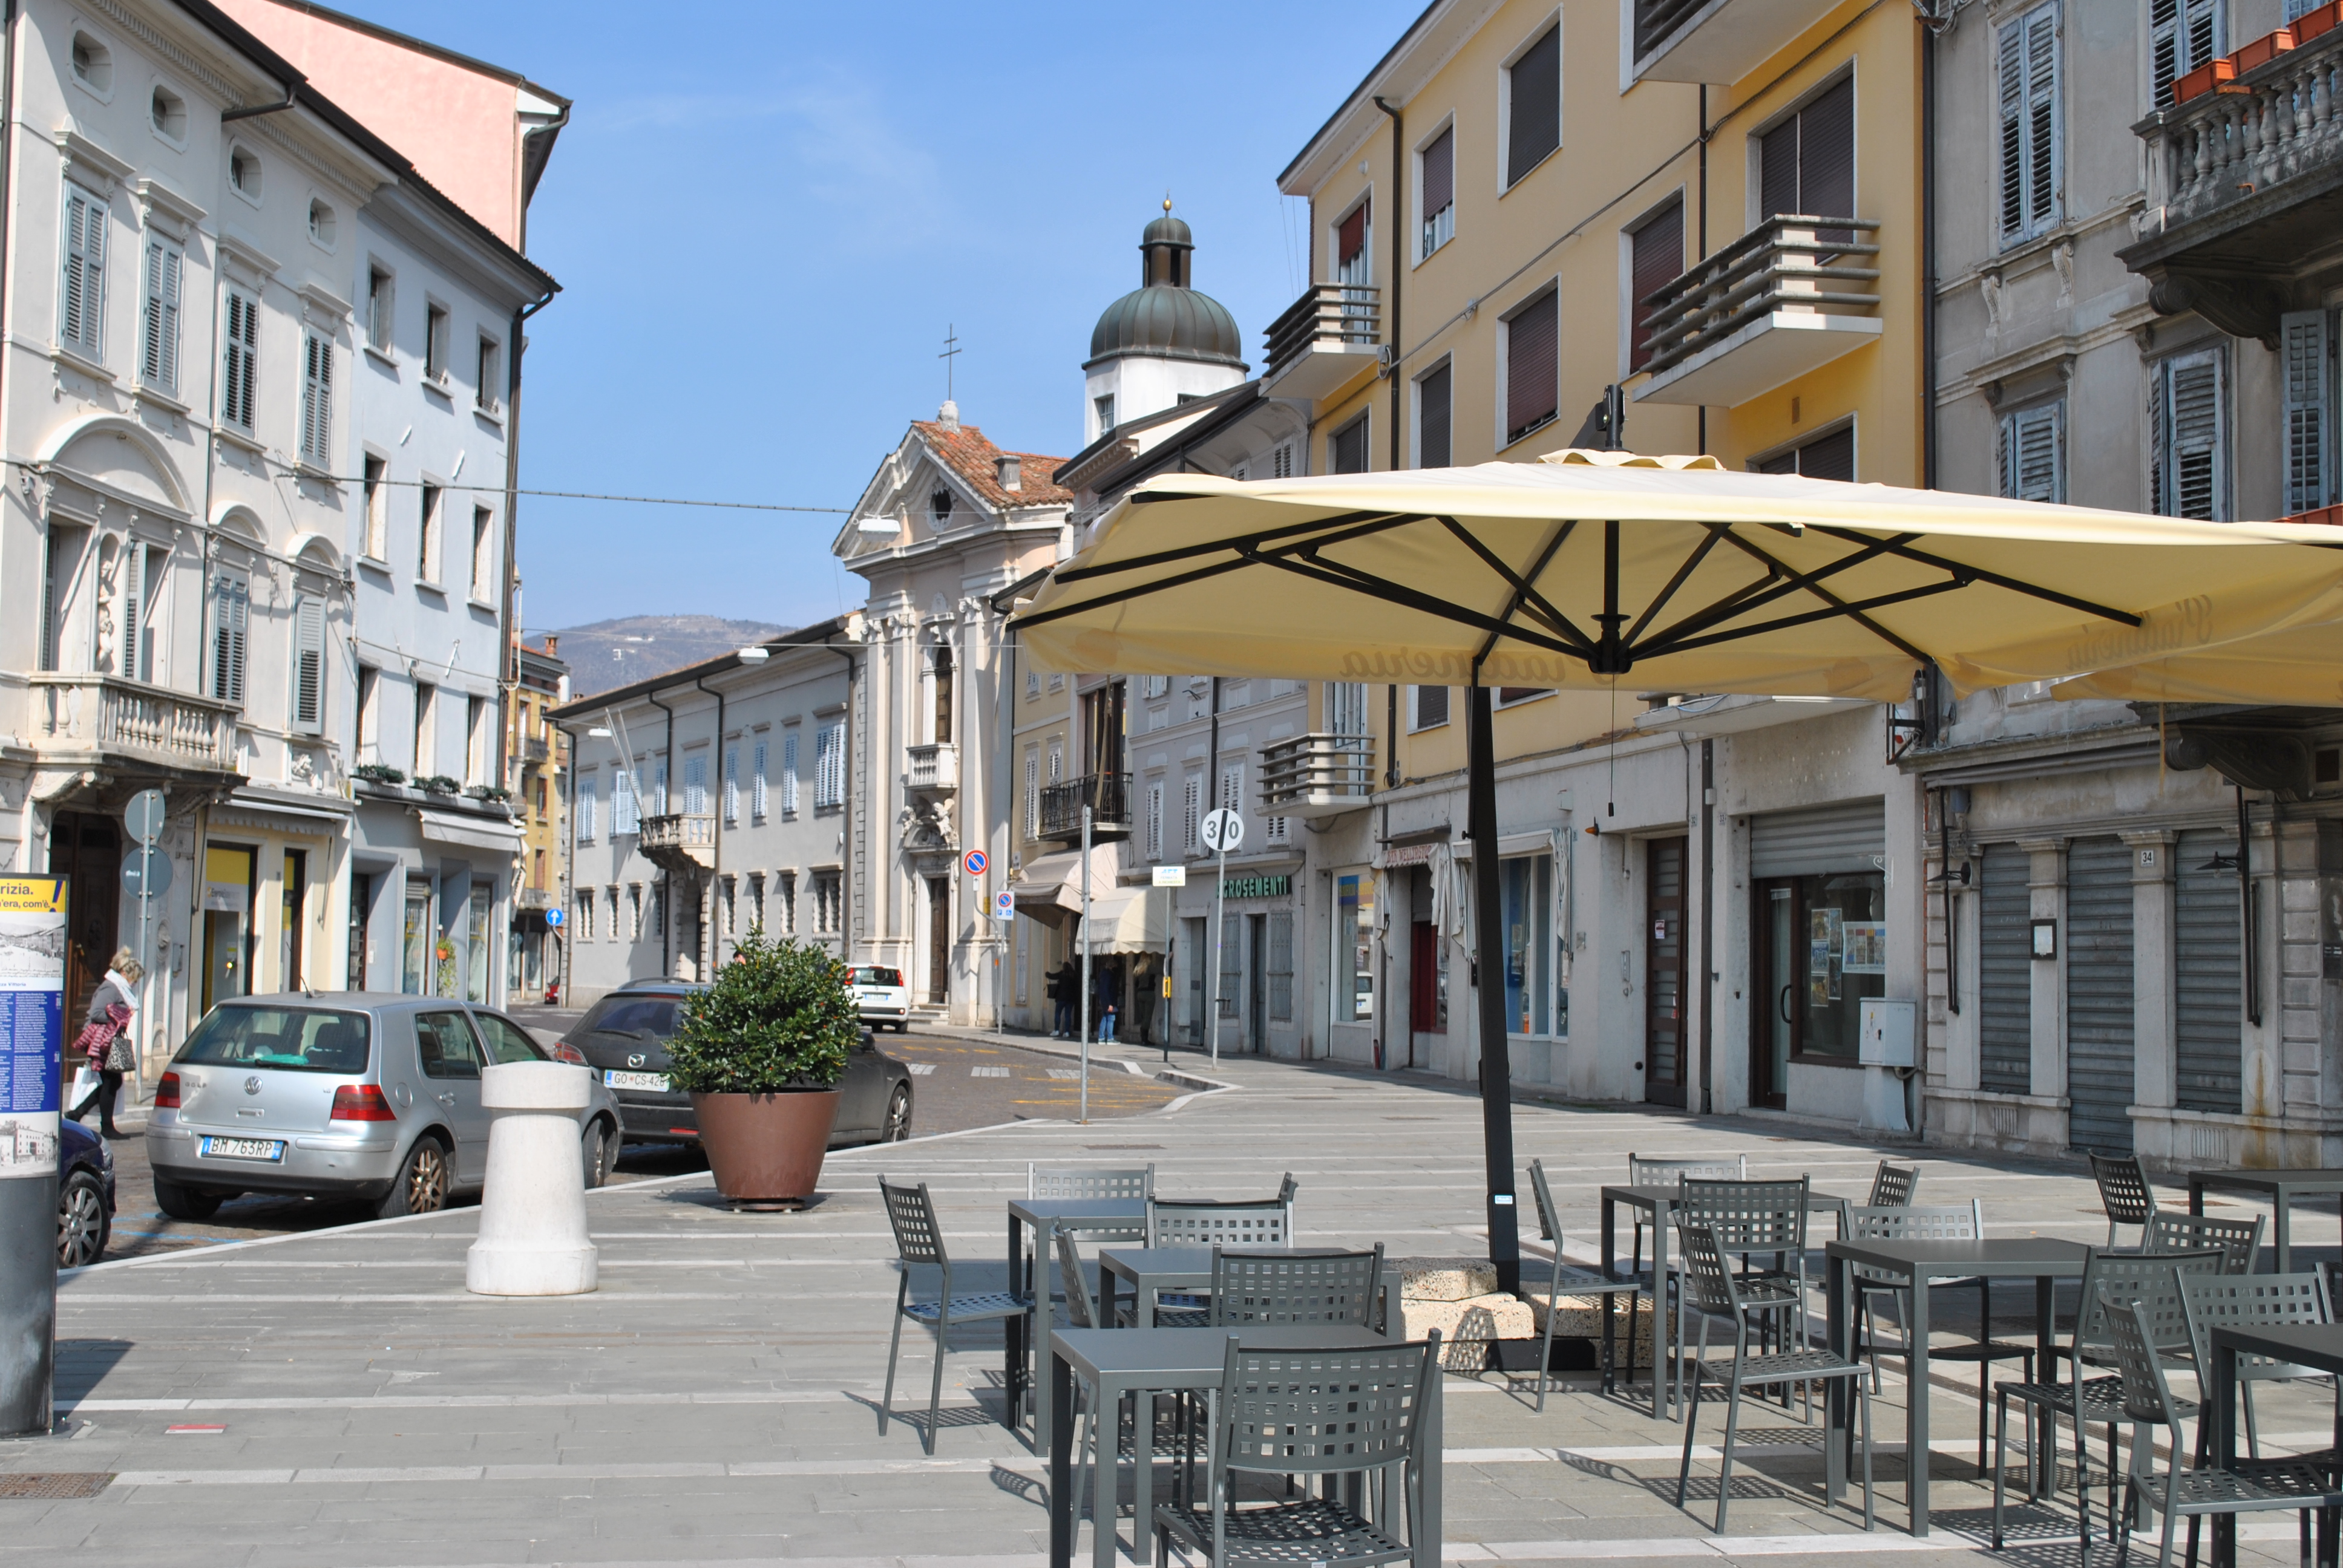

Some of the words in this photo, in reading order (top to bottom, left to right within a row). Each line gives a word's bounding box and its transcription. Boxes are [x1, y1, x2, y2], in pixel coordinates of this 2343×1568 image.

[2143, 851, 2152, 863] 34
[0, 899, 21, 909] 'era,
[615, 1073, 628, 1084] GO
[232, 1139, 272, 1156] 763RP
